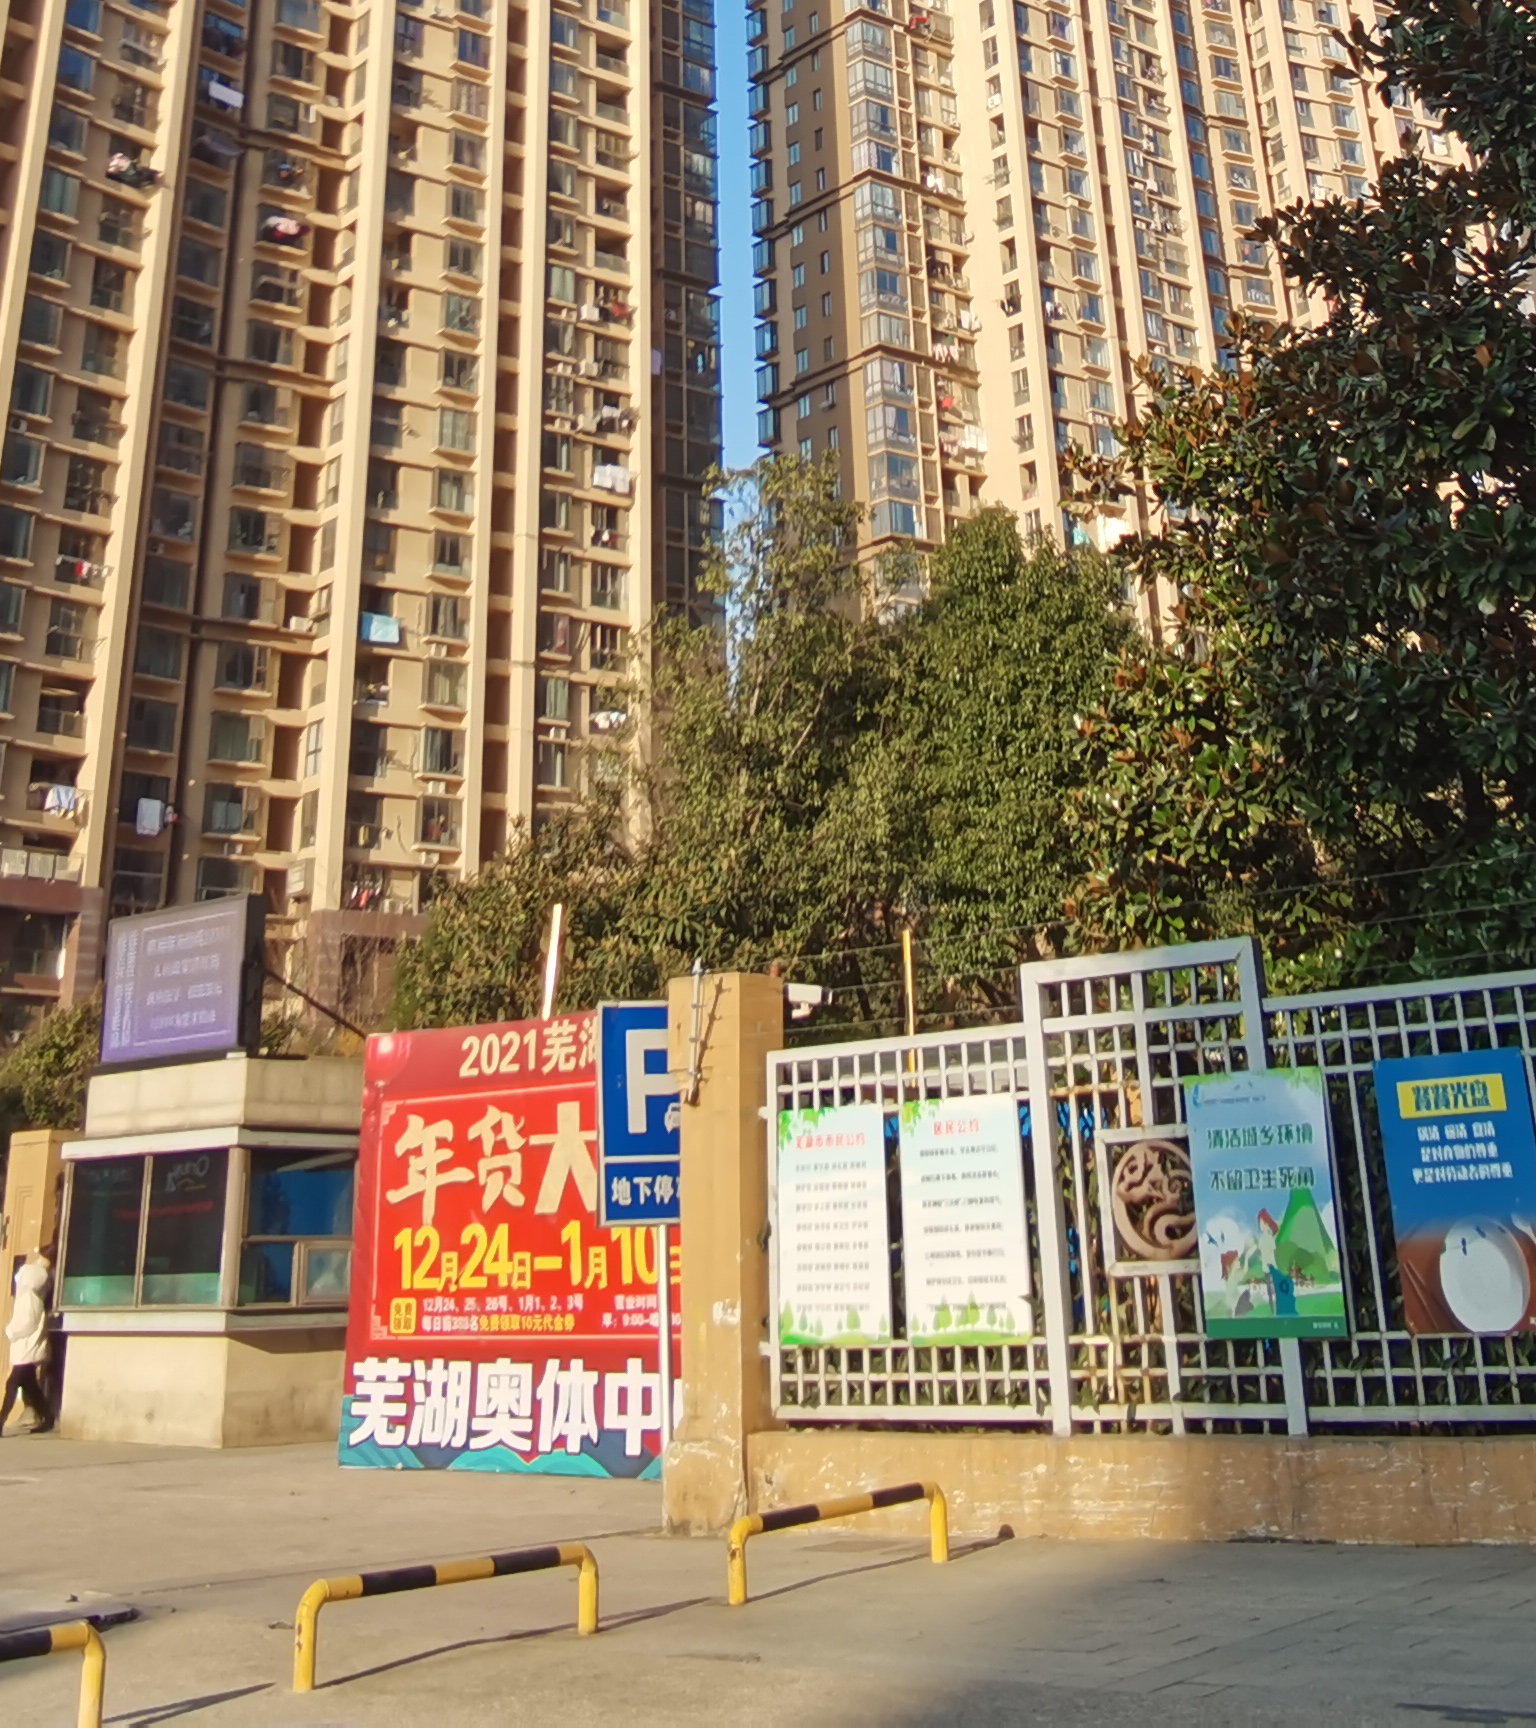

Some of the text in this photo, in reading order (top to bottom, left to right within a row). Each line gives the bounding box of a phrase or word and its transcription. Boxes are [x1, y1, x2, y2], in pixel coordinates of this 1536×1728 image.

[1207, 1123, 1313, 1149] 清洁城乡环境
[386, 1101, 597, 1226] 年货大
[611, 1174, 680, 1206] 地下停
[1210, 1166, 1315, 1191] 不留卫生死角
